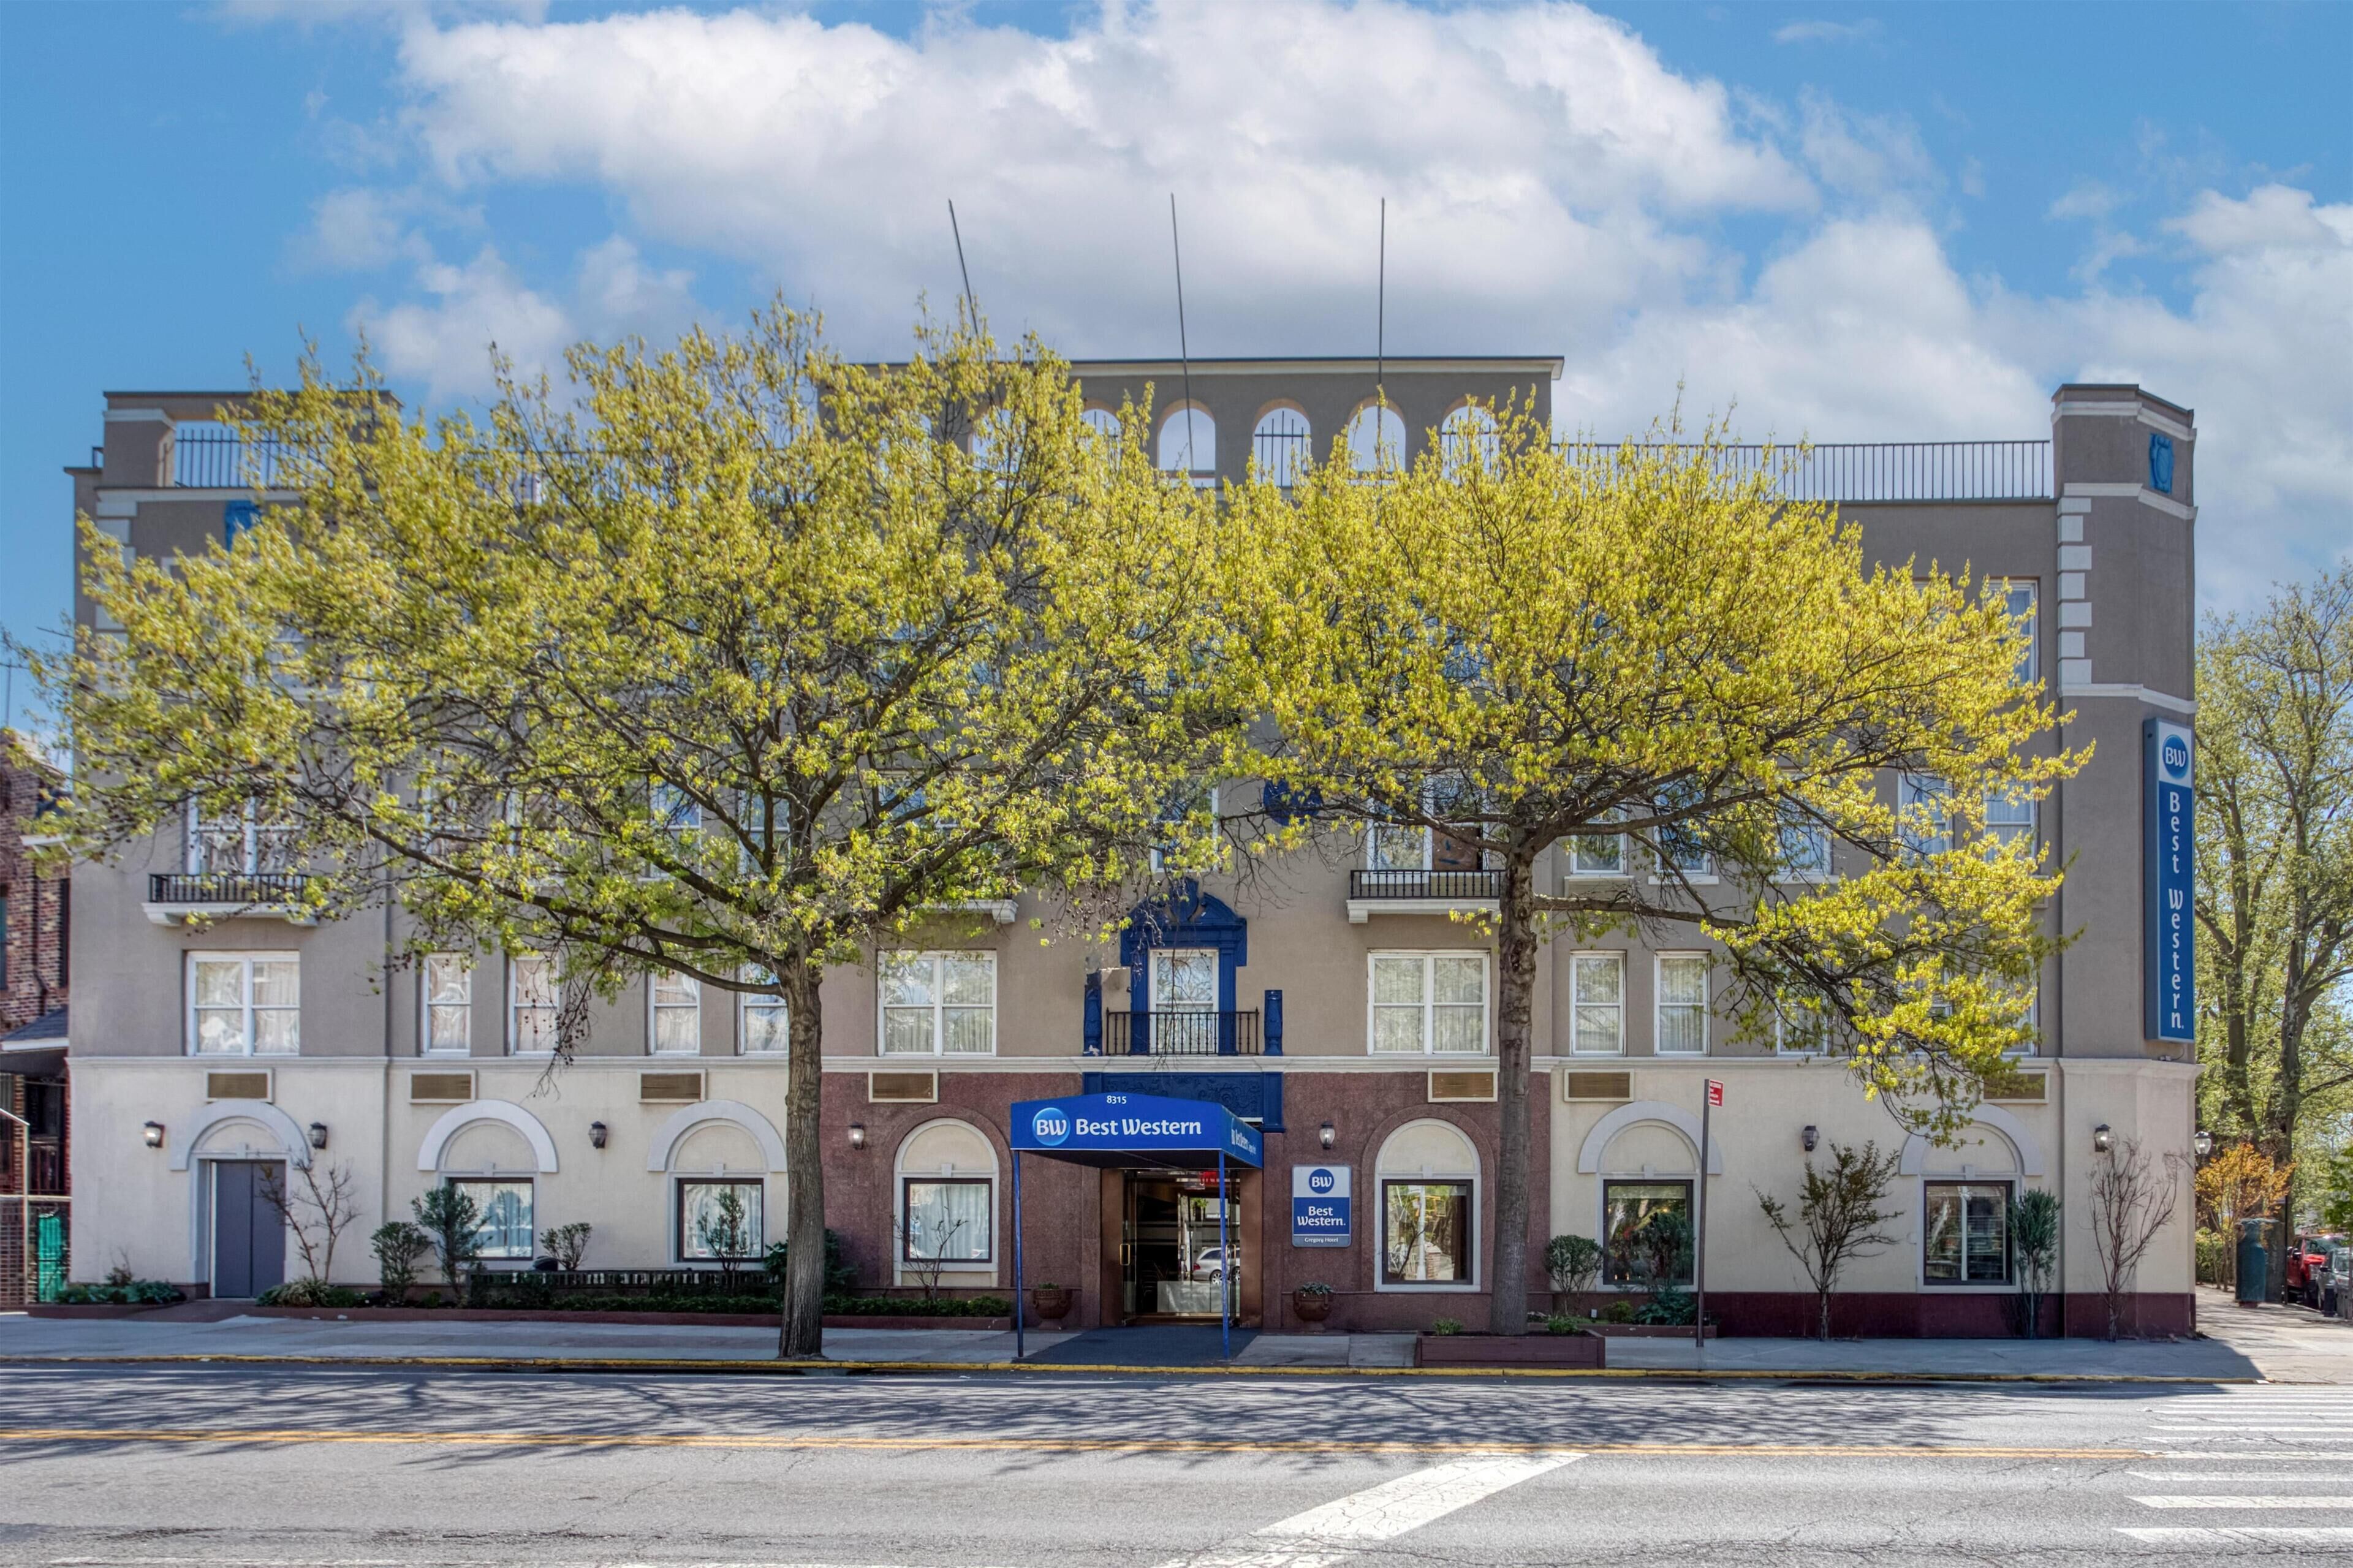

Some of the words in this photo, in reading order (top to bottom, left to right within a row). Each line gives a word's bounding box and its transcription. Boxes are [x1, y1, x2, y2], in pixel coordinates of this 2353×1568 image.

[2165, 746, 2186, 768] BW
[2169, 791, 2181, 874] Best
[1106, 1095, 1127, 1104] 8315
[1036, 1119, 1067, 1135] BW
[1075, 1118, 1119, 1135] Best
[1121, 1118, 1202, 1135] Western
[1311, 1176, 1332, 1187] BW
[1308, 1206, 1333, 1216] Best
